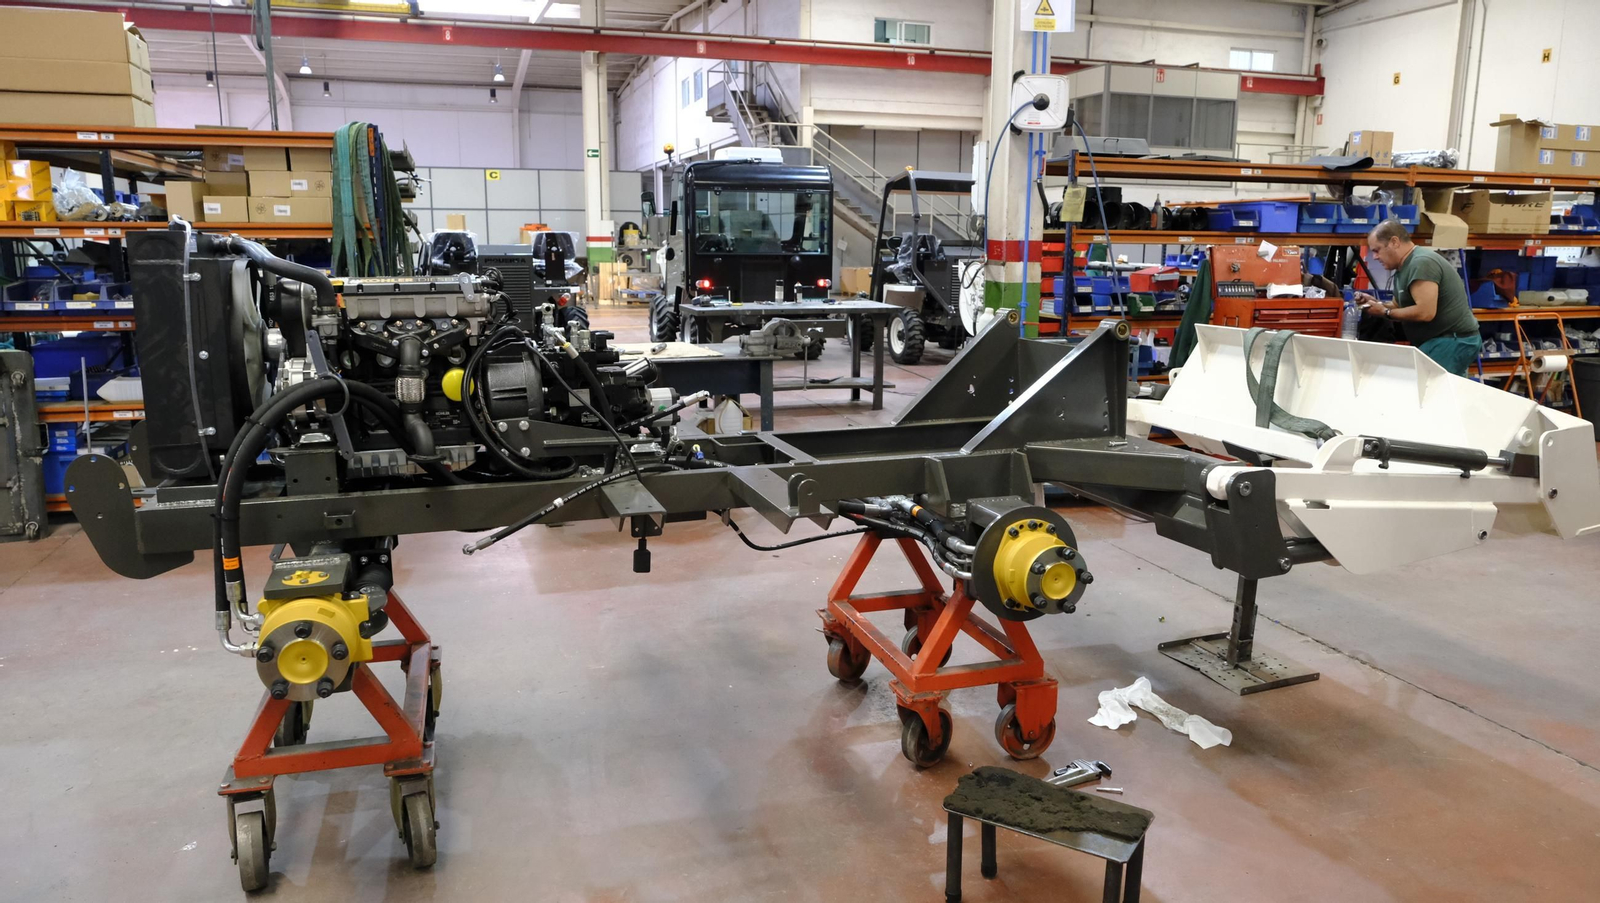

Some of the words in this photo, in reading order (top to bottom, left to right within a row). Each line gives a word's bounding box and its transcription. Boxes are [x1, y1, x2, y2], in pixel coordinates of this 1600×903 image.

[445, 30, 451, 40] 8
[907, 55, 915, 65] 10
[1542, 52, 1550, 62] H
[1157, 72, 1163, 82] 11
[1393, 76, 1400, 84] G
[1246, 79, 1253, 88] 12
[489, 171, 498, 179] C
